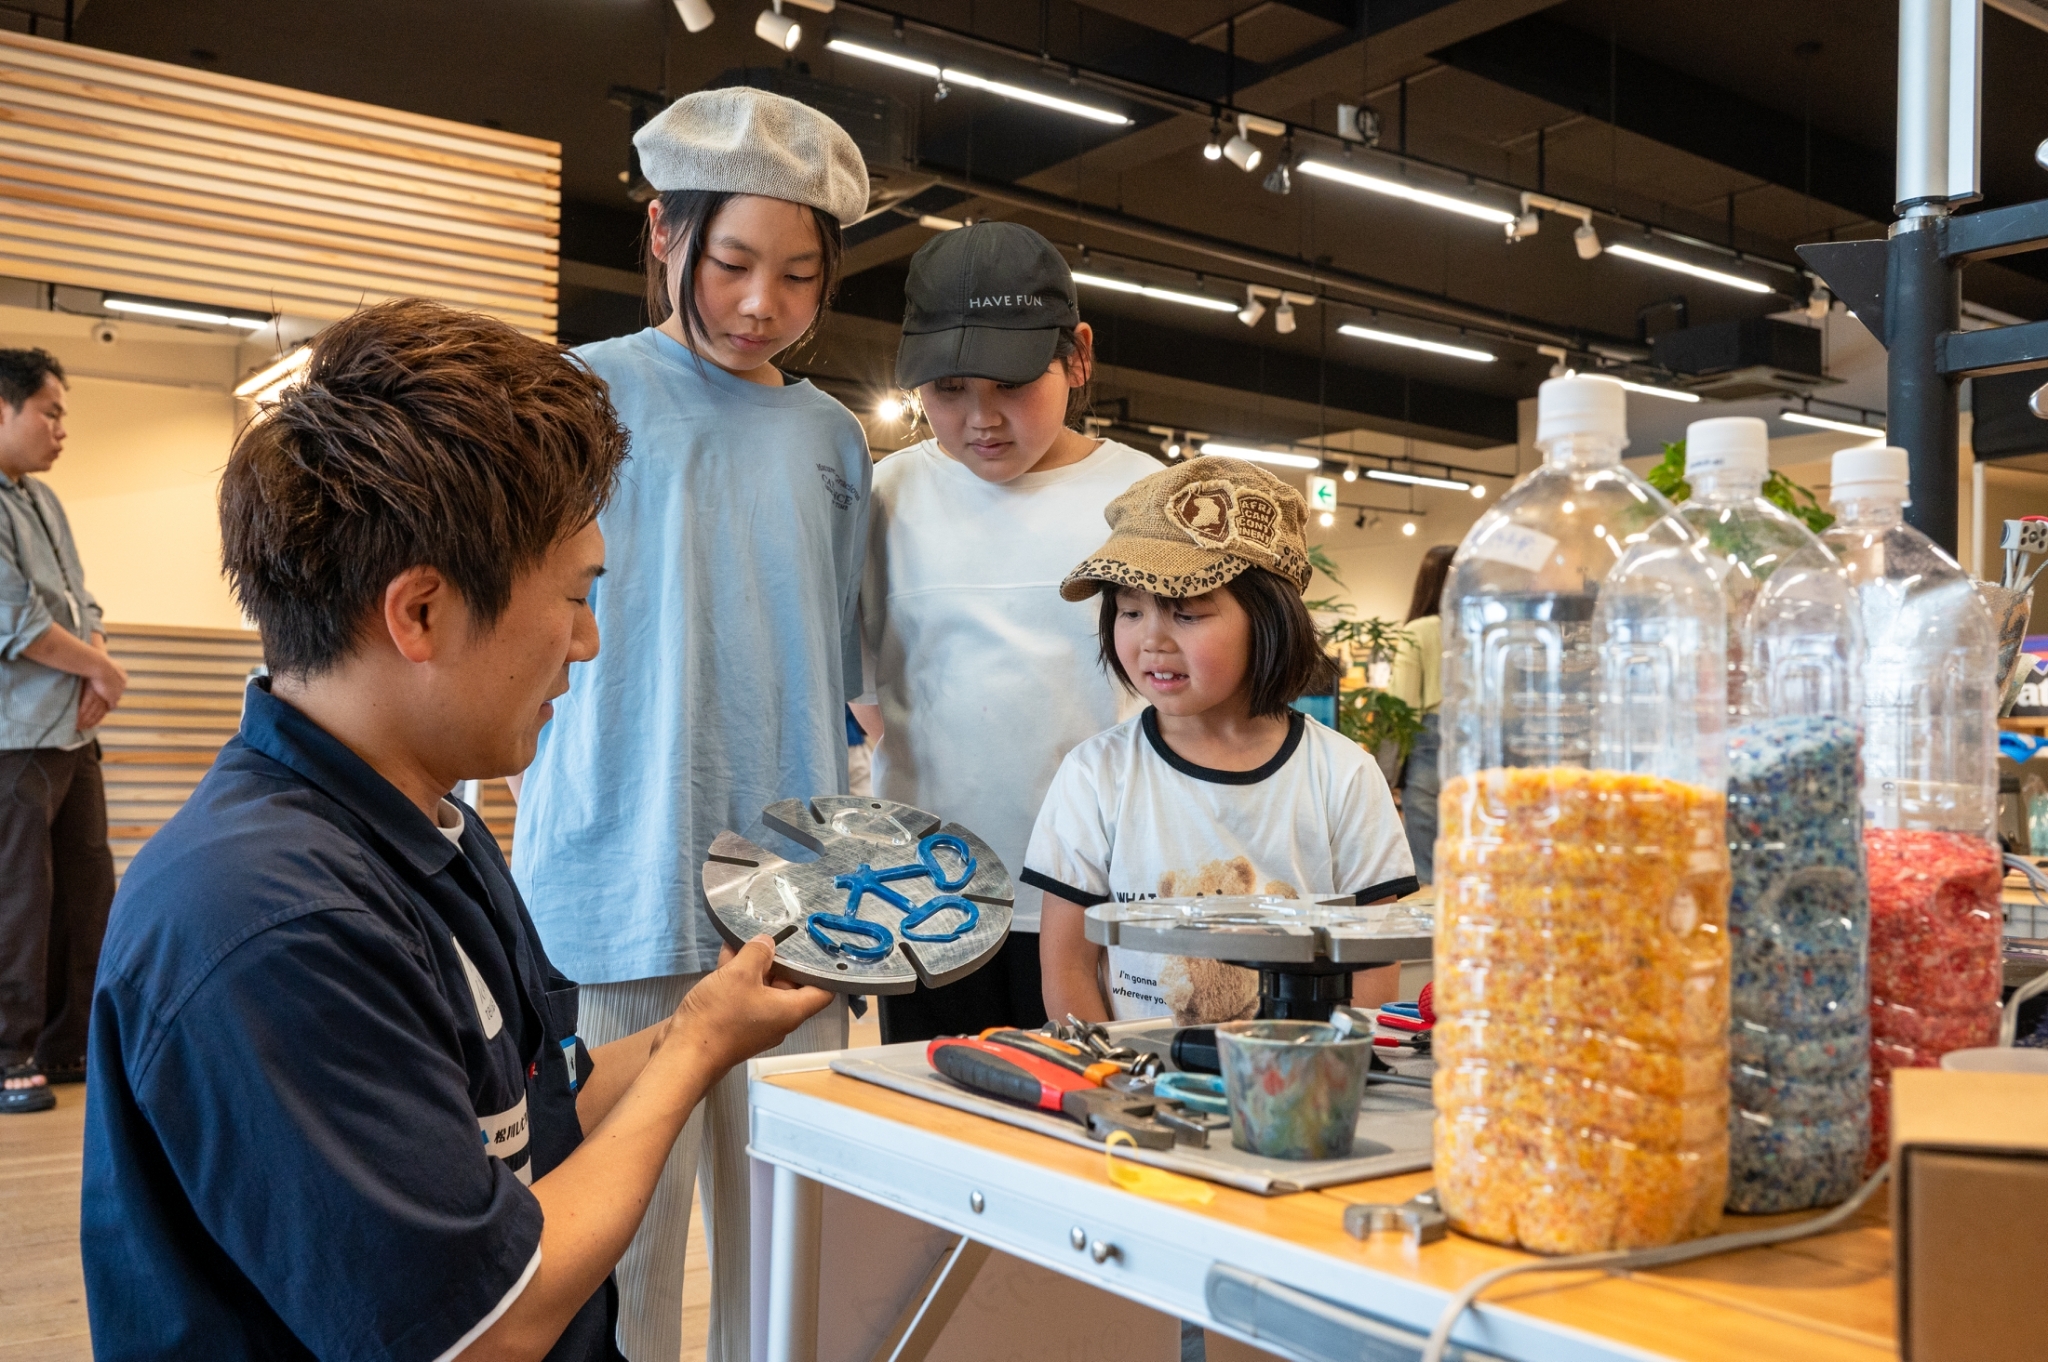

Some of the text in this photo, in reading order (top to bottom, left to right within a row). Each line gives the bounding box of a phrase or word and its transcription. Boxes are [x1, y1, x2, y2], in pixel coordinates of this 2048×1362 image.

[969, 294, 1043, 309] HAVE FUN
[1241, 500, 1272, 515] AFRI
[1244, 509, 1269, 523] CAN
[1239, 517, 1269, 533] CONT
[1238, 527, 1270, 543] INENT
[1116, 891, 1157, 903] WHAT
[1119, 970, 1158, 987] I'm gonna
[1112, 987, 1167, 1005] wherever yo
